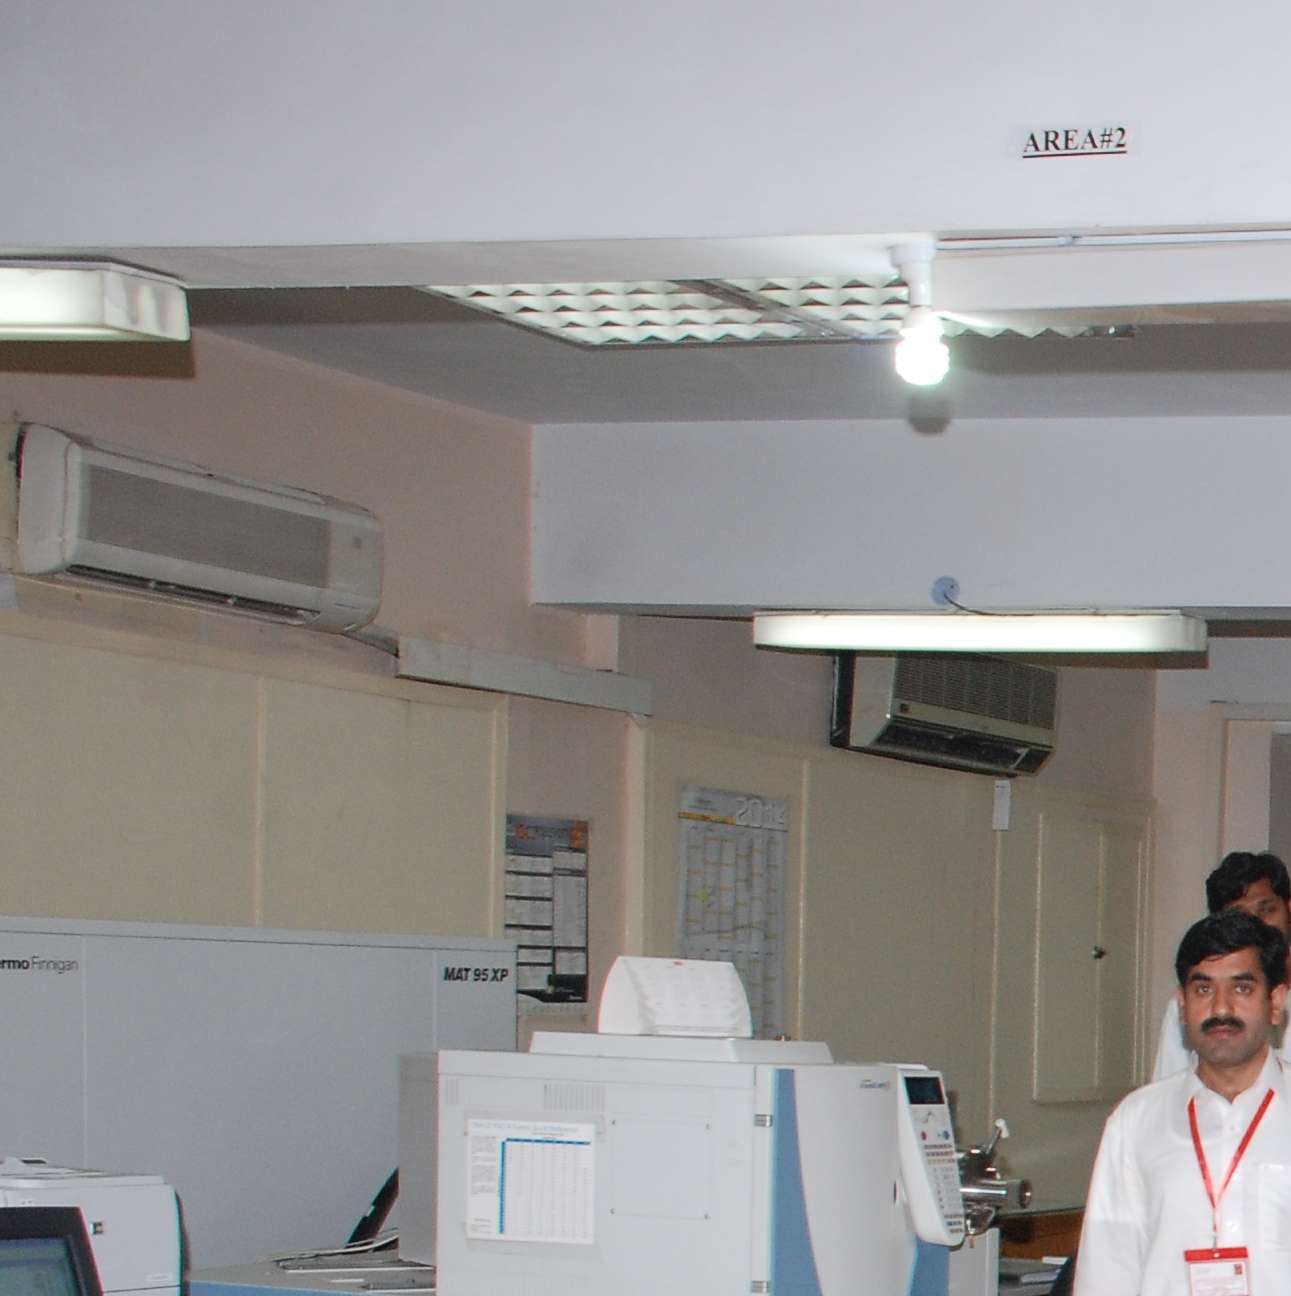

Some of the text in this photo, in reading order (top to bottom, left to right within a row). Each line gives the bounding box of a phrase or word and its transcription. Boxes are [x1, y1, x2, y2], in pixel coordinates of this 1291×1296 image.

[1023, 127, 1127, 153] AREA#2
[444, 967, 509, 982] MAT 95 XP
